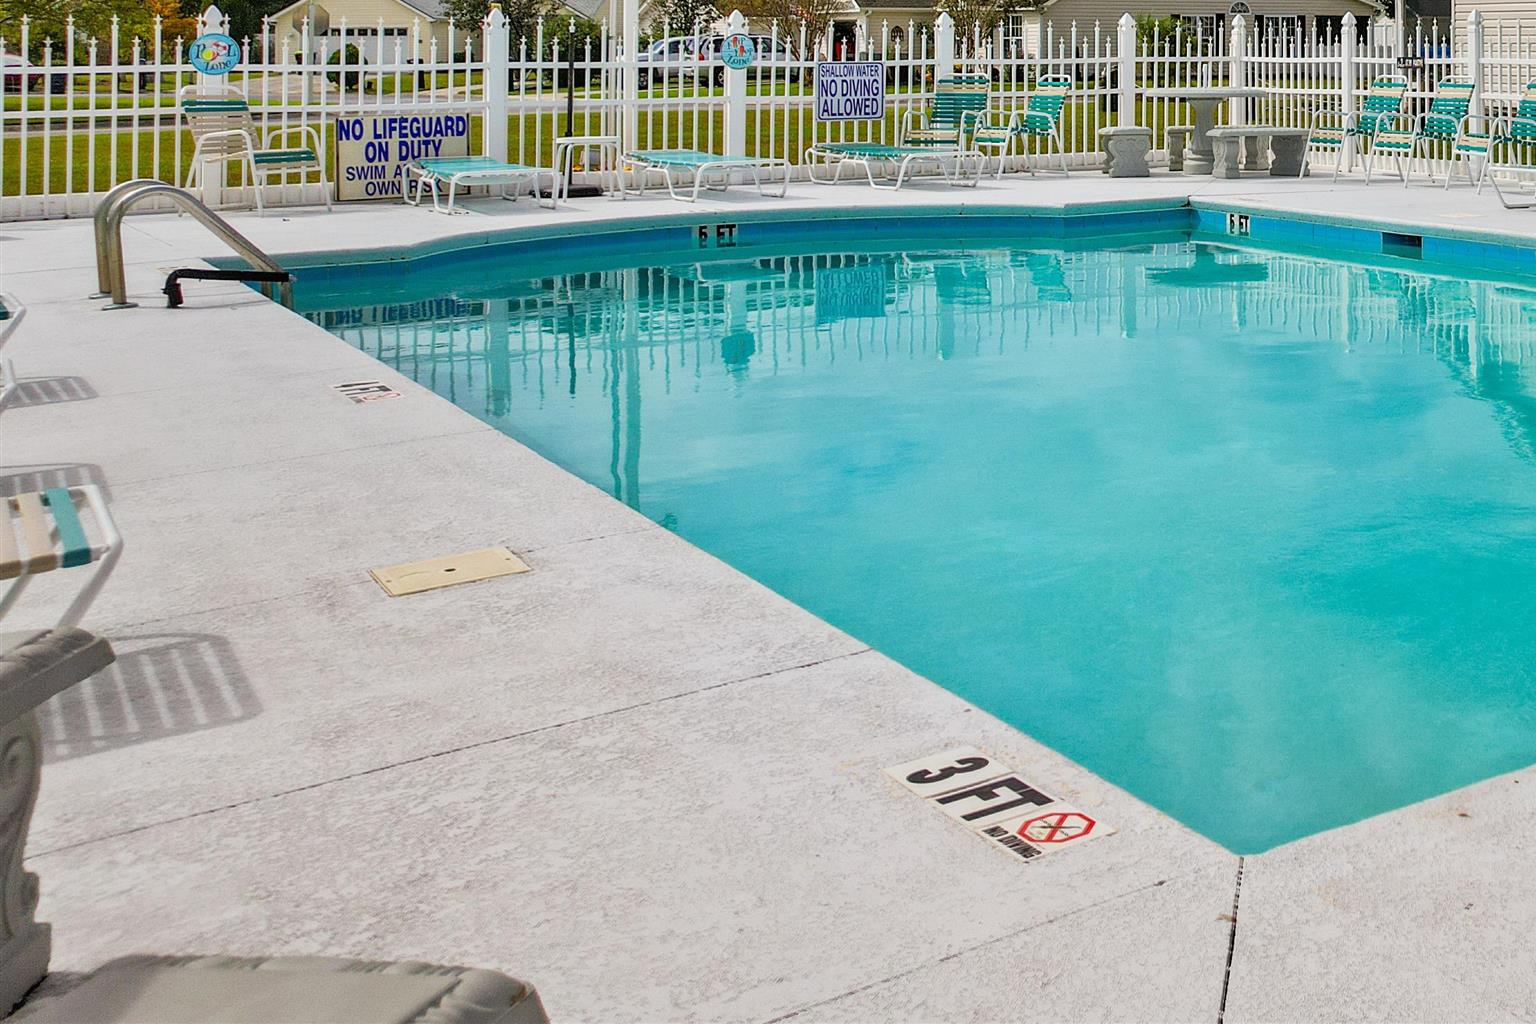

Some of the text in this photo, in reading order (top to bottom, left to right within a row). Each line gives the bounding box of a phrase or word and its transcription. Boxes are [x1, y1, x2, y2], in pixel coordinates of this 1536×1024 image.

[821, 65, 879, 77] SHALLOW WATER
[821, 79, 880, 97] NO DIVING
[821, 98, 879, 116] ALLOWED
[338, 115, 467, 140] NO LIFEGUARD
[364, 138, 443, 163] ON DUTY
[346, 165, 386, 181] SWIM
[365, 178, 443, 196] OWN RSK
[905, 757, 1056, 822] 3 FT
[981, 825, 1042, 859] NO DIVING
